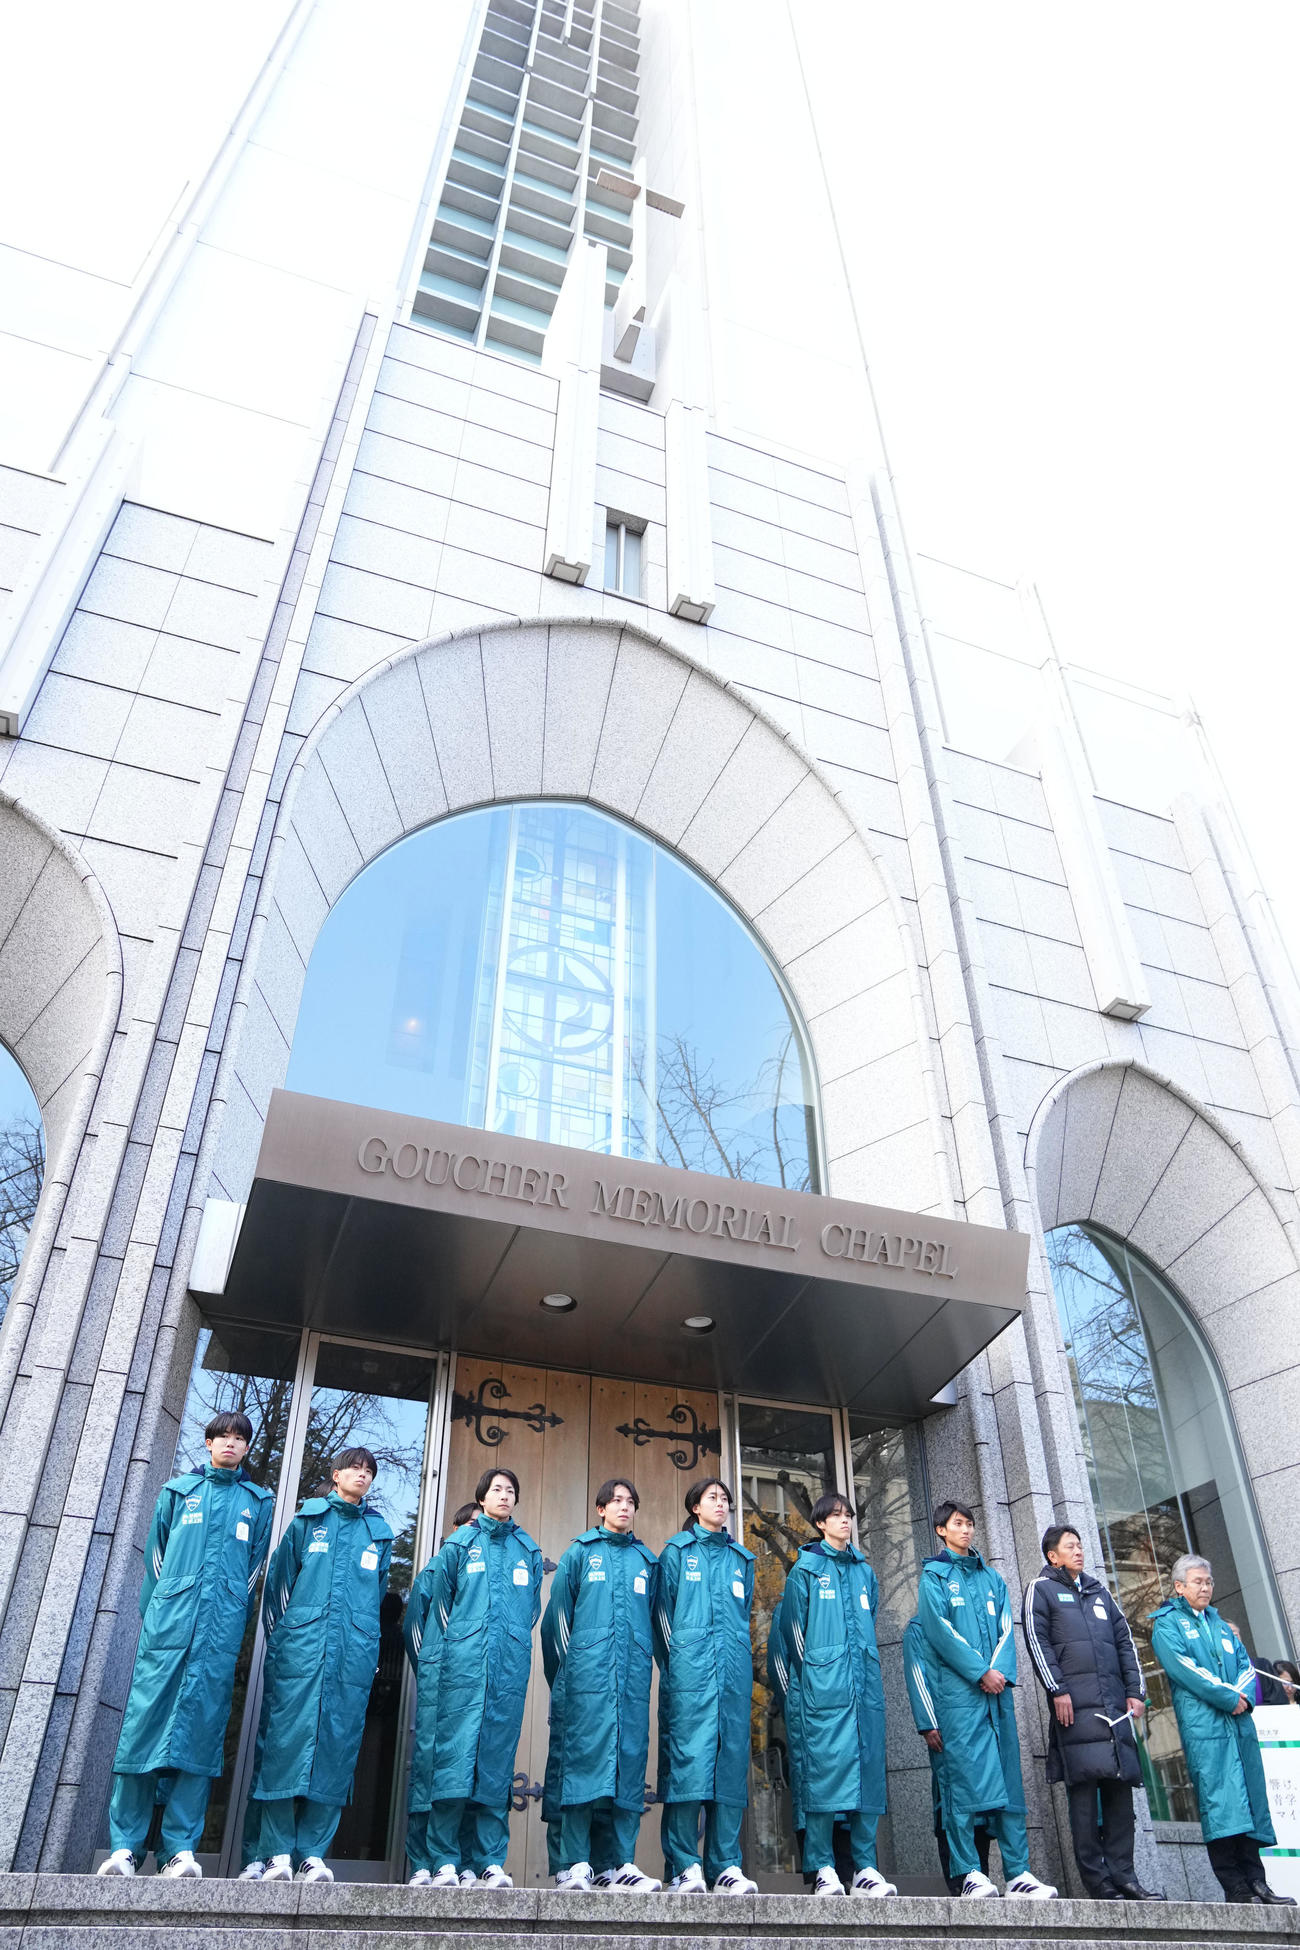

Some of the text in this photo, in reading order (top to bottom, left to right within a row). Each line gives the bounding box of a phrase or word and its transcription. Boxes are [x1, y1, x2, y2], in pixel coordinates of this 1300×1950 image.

[357, 1136, 959, 1279] GOUCHER MEMORIAL CHAPEL
